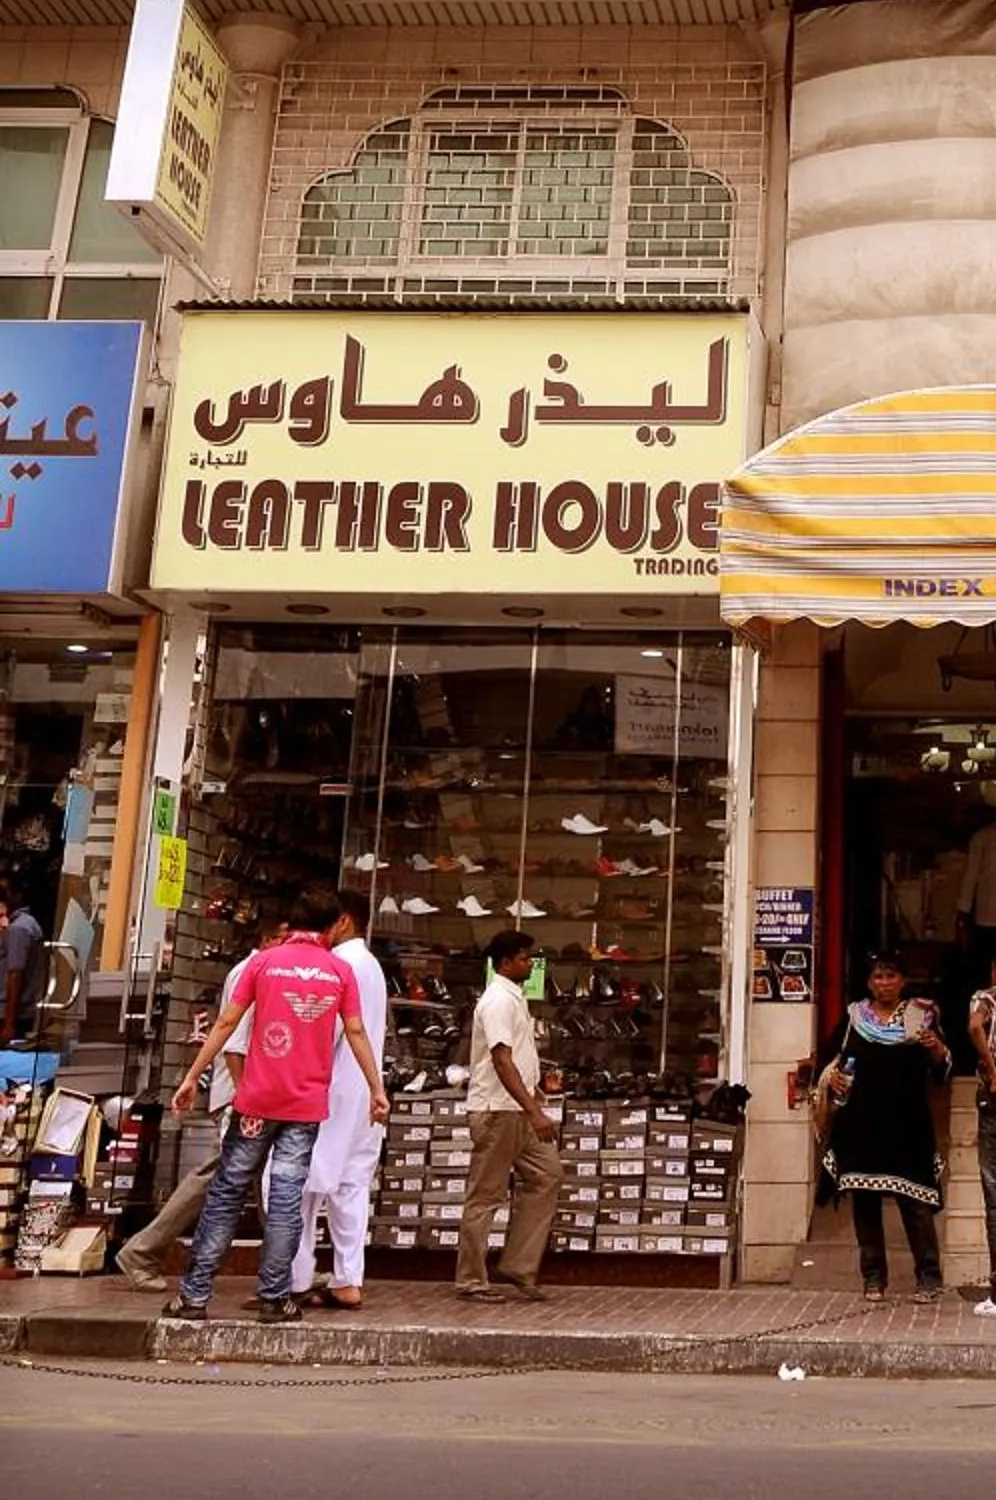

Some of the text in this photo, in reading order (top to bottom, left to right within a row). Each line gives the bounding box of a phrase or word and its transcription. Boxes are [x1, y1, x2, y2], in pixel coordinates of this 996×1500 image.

[193, 333, 731, 447] ليذر هاوس
[188, 449, 248, 470] للتجارة
[181, 478, 721, 555] LEATHER HOUSE
[633, 556, 720, 577] TRADING
[885, 576, 984, 597] INDEX
